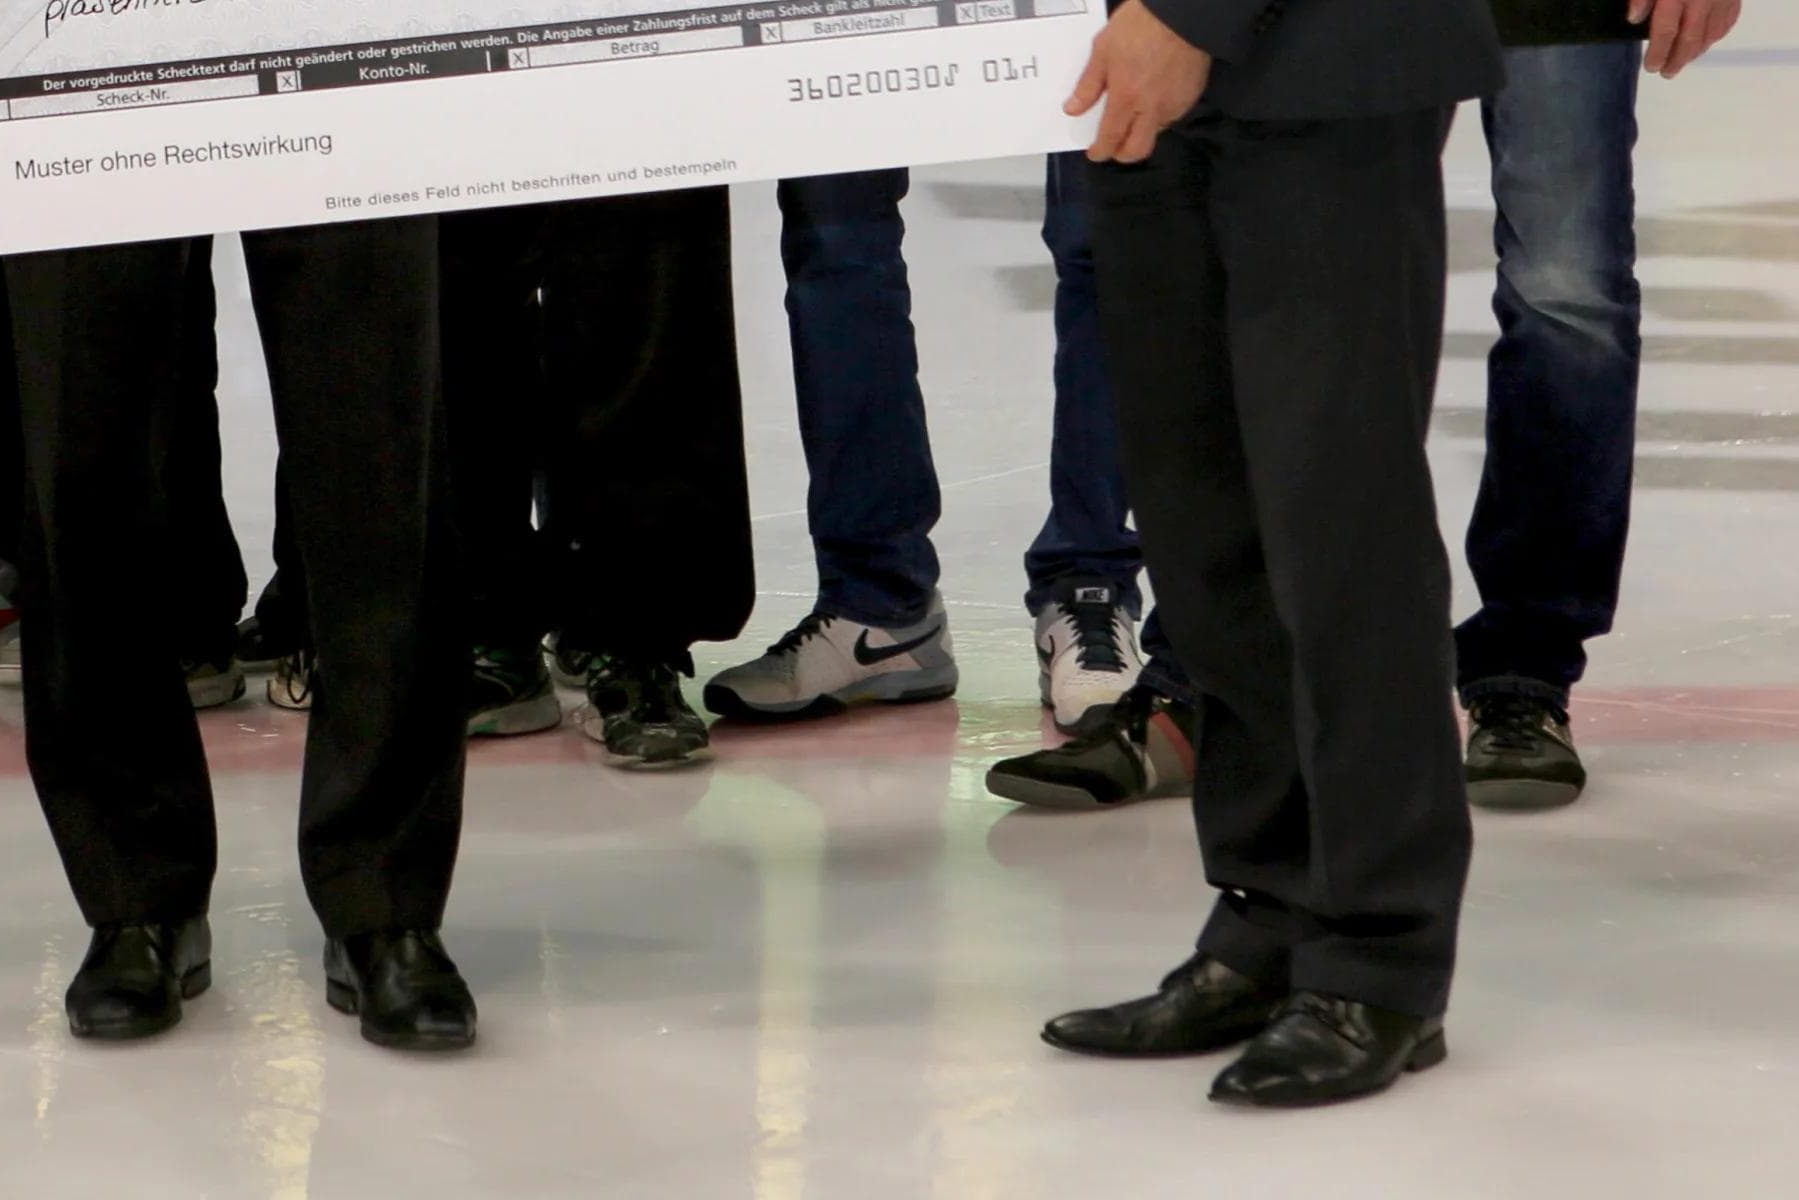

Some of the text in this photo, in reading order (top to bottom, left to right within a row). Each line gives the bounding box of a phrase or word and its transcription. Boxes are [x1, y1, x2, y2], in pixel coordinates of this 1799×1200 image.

[980, 1, 1011, 18] Text
[813, 13, 906, 35] Bankleitzahl
[43, 79, 66, 91] Der
[69, 69, 155, 90] vorgedruckte
[157, 62, 226, 81] Schecktext
[229, 58, 256, 73] darf
[260, 54, 292, 70] nicht
[296, 50, 354, 69] geändert
[357, 47, 389, 61] oder
[391, 39, 458, 59] gestrichen
[460, 33, 515, 50] werden.
[517, 31, 540, 44] Die
[543, 25, 593, 43] Angabe
[596, 21, 630, 36] einer
[633, 10, 718, 33] Zahlungsfrist
[721, 9, 743, 24] auf
[746, 6, 776, 21] dem
[778, 1, 822, 17] Scheck
[610, 40, 660, 56] Betrag
[358, 62, 431, 81] Konto-Nr.
[96, 88, 171, 107] Scheck-Nr.
[15, 134, 333, 180] Muster ohne Rechtswirkung
[326, 157, 737, 210] Bitte dieses Feld nicht beschriften und bestempeln
